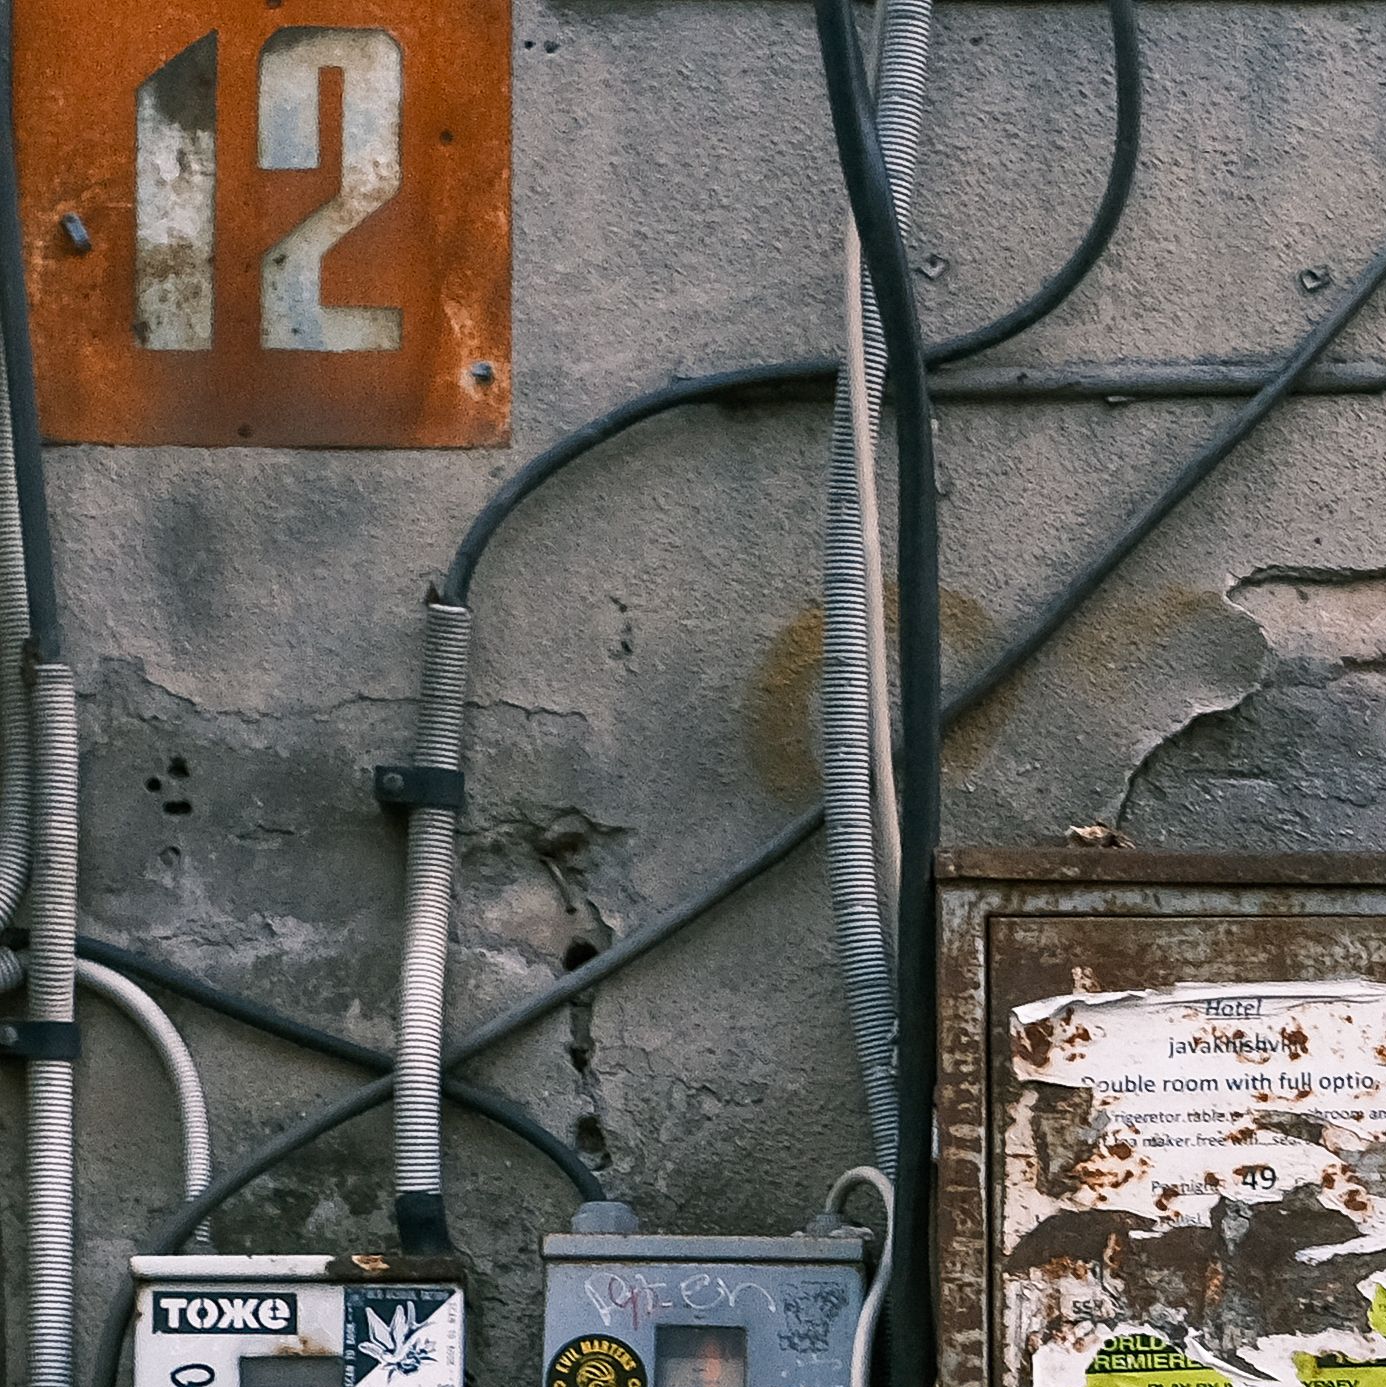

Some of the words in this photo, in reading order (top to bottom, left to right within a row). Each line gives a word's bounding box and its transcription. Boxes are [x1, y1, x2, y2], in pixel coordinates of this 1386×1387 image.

[134, 26, 403, 351] 12
[1206, 999, 1263, 1017] Hotel
[1163, 1078, 1219, 1093] room
[1227, 1074, 1272, 1092] with
[1279, 1073, 1312, 1092] full
[1319, 1074, 1378, 1095] optio
[1241, 1166, 1278, 1191] 49
[1102, 1334, 1167, 1352] ORLD
[1094, 1352, 1203, 1371] REMIERE
